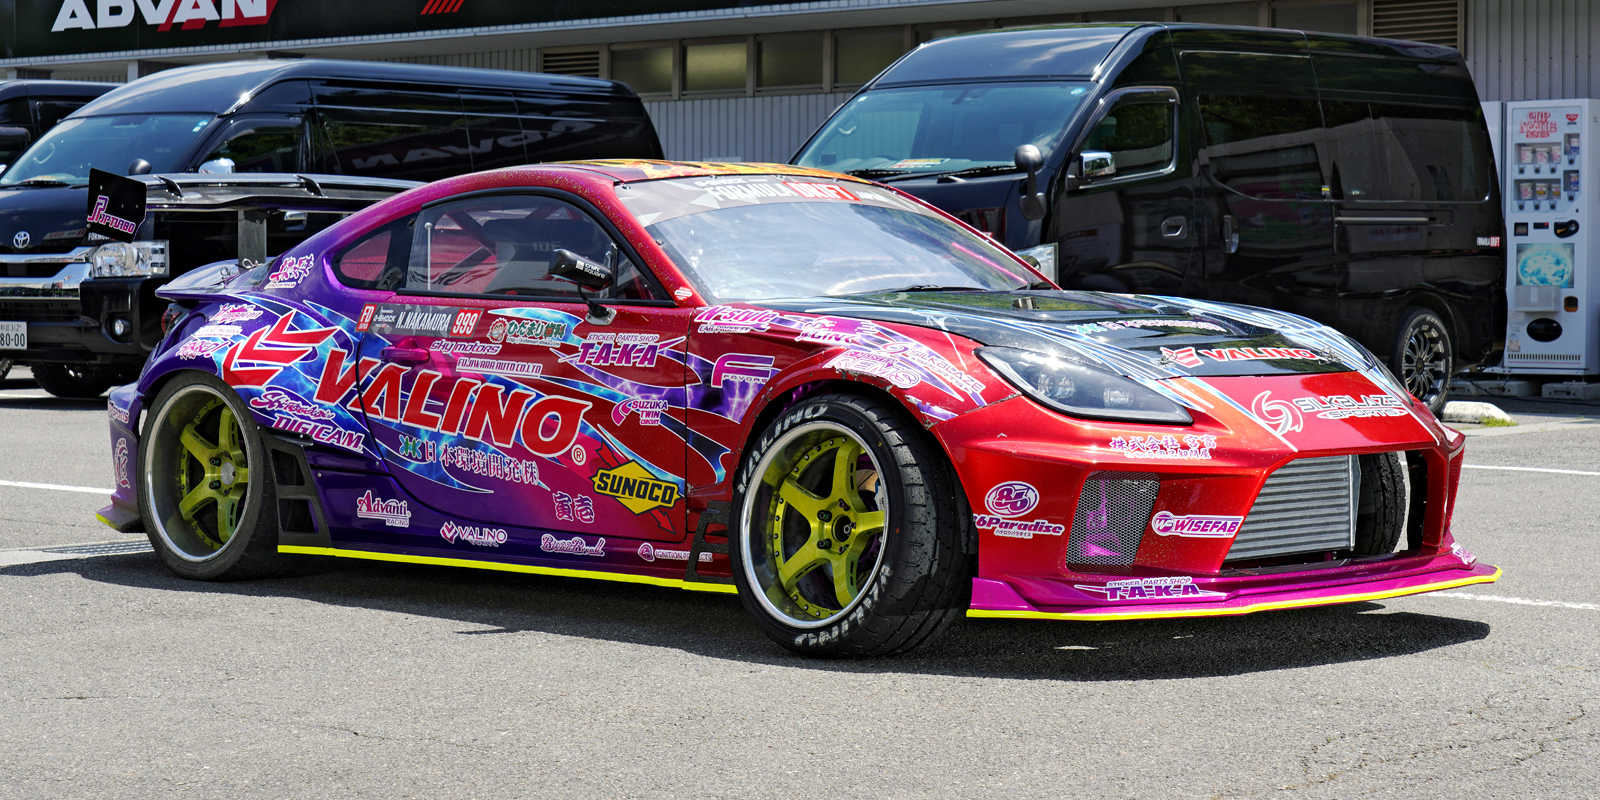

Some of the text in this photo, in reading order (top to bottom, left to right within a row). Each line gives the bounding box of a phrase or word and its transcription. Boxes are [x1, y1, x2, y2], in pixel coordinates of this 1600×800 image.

[51, 0, 272, 32] ADVAN
[704, 182, 798, 201] FORMULA
[786, 182, 855, 200] DRIFT
[360, 305, 375, 322] FD
[452, 313, 478, 335] 999
[507, 320, 567, 339] ひだまり歯科
[1198, 348, 1319, 361] VALINO
[457, 358, 494, 370] FUJIWARA
[495, 361, 516, 371] AUTO
[312, 347, 593, 458] VALINO
[632, 400, 668, 410] SUZUKA
[1293, 395, 1403, 412] SILKBLAZE
[640, 410, 661, 418] TWIN
[1328, 408, 1398, 418] SPORTS
[273, 414, 364, 450] DIGICAM
[1109, 435, 1181, 451] 株式会社
[596, 472, 677, 504] SUNOCO
[357, 490, 409, 515] Advanti
[386, 518, 409, 526] RACING
[1175, 517, 1239, 533] WISEFAB
[459, 526, 508, 544] VALINO
[655, 549, 683, 560] IGNITION
[1107, 579, 1140, 587] STICKER
[1143, 578, 1168, 586] PARTS
